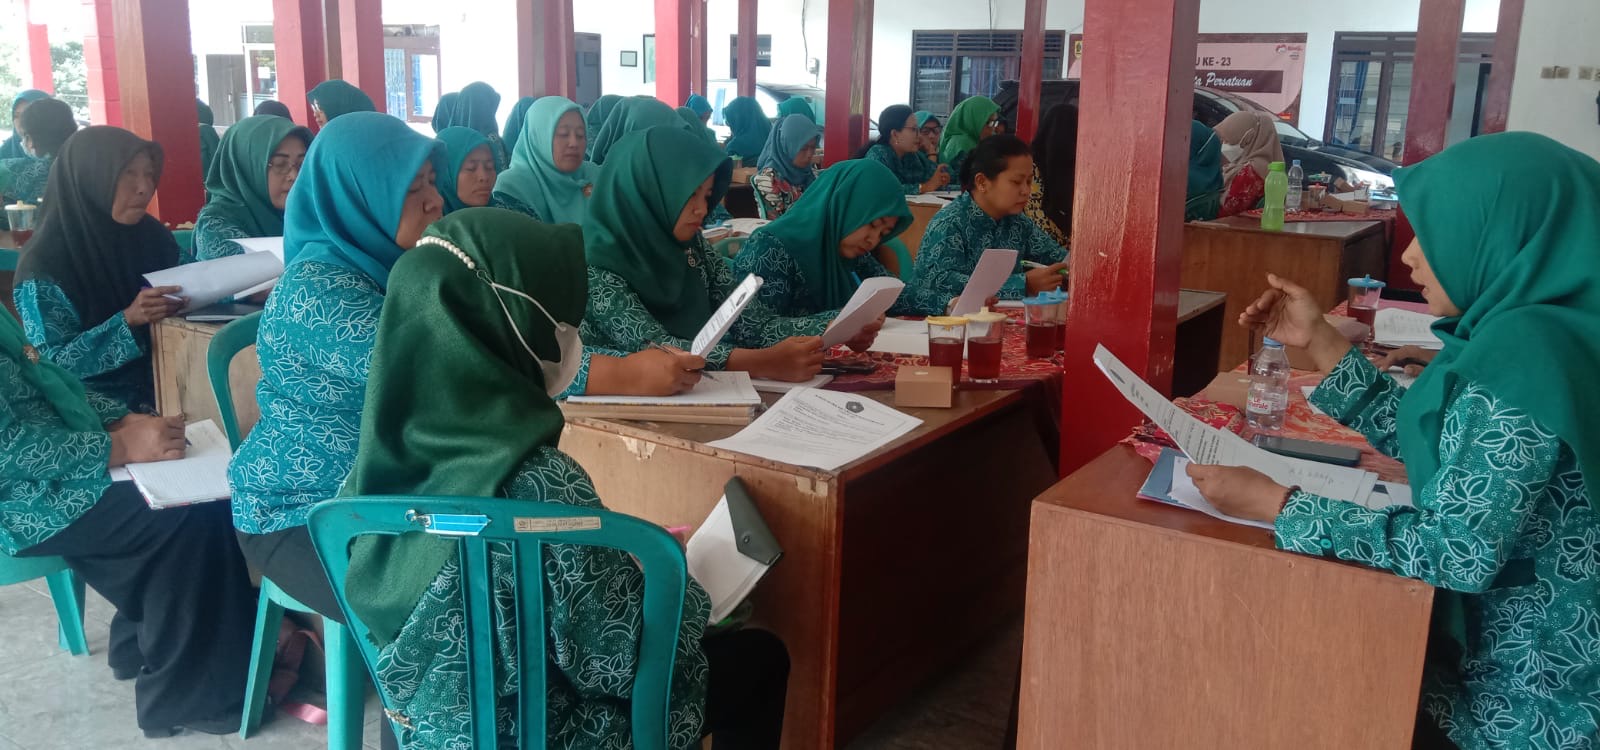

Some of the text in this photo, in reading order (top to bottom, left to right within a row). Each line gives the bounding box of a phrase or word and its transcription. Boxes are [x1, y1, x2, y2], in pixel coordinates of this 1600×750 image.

[1202, 57, 1215, 66] KE
[1220, 57, 1231, 66] 23
[1205, 72, 1253, 87] Persatuan
